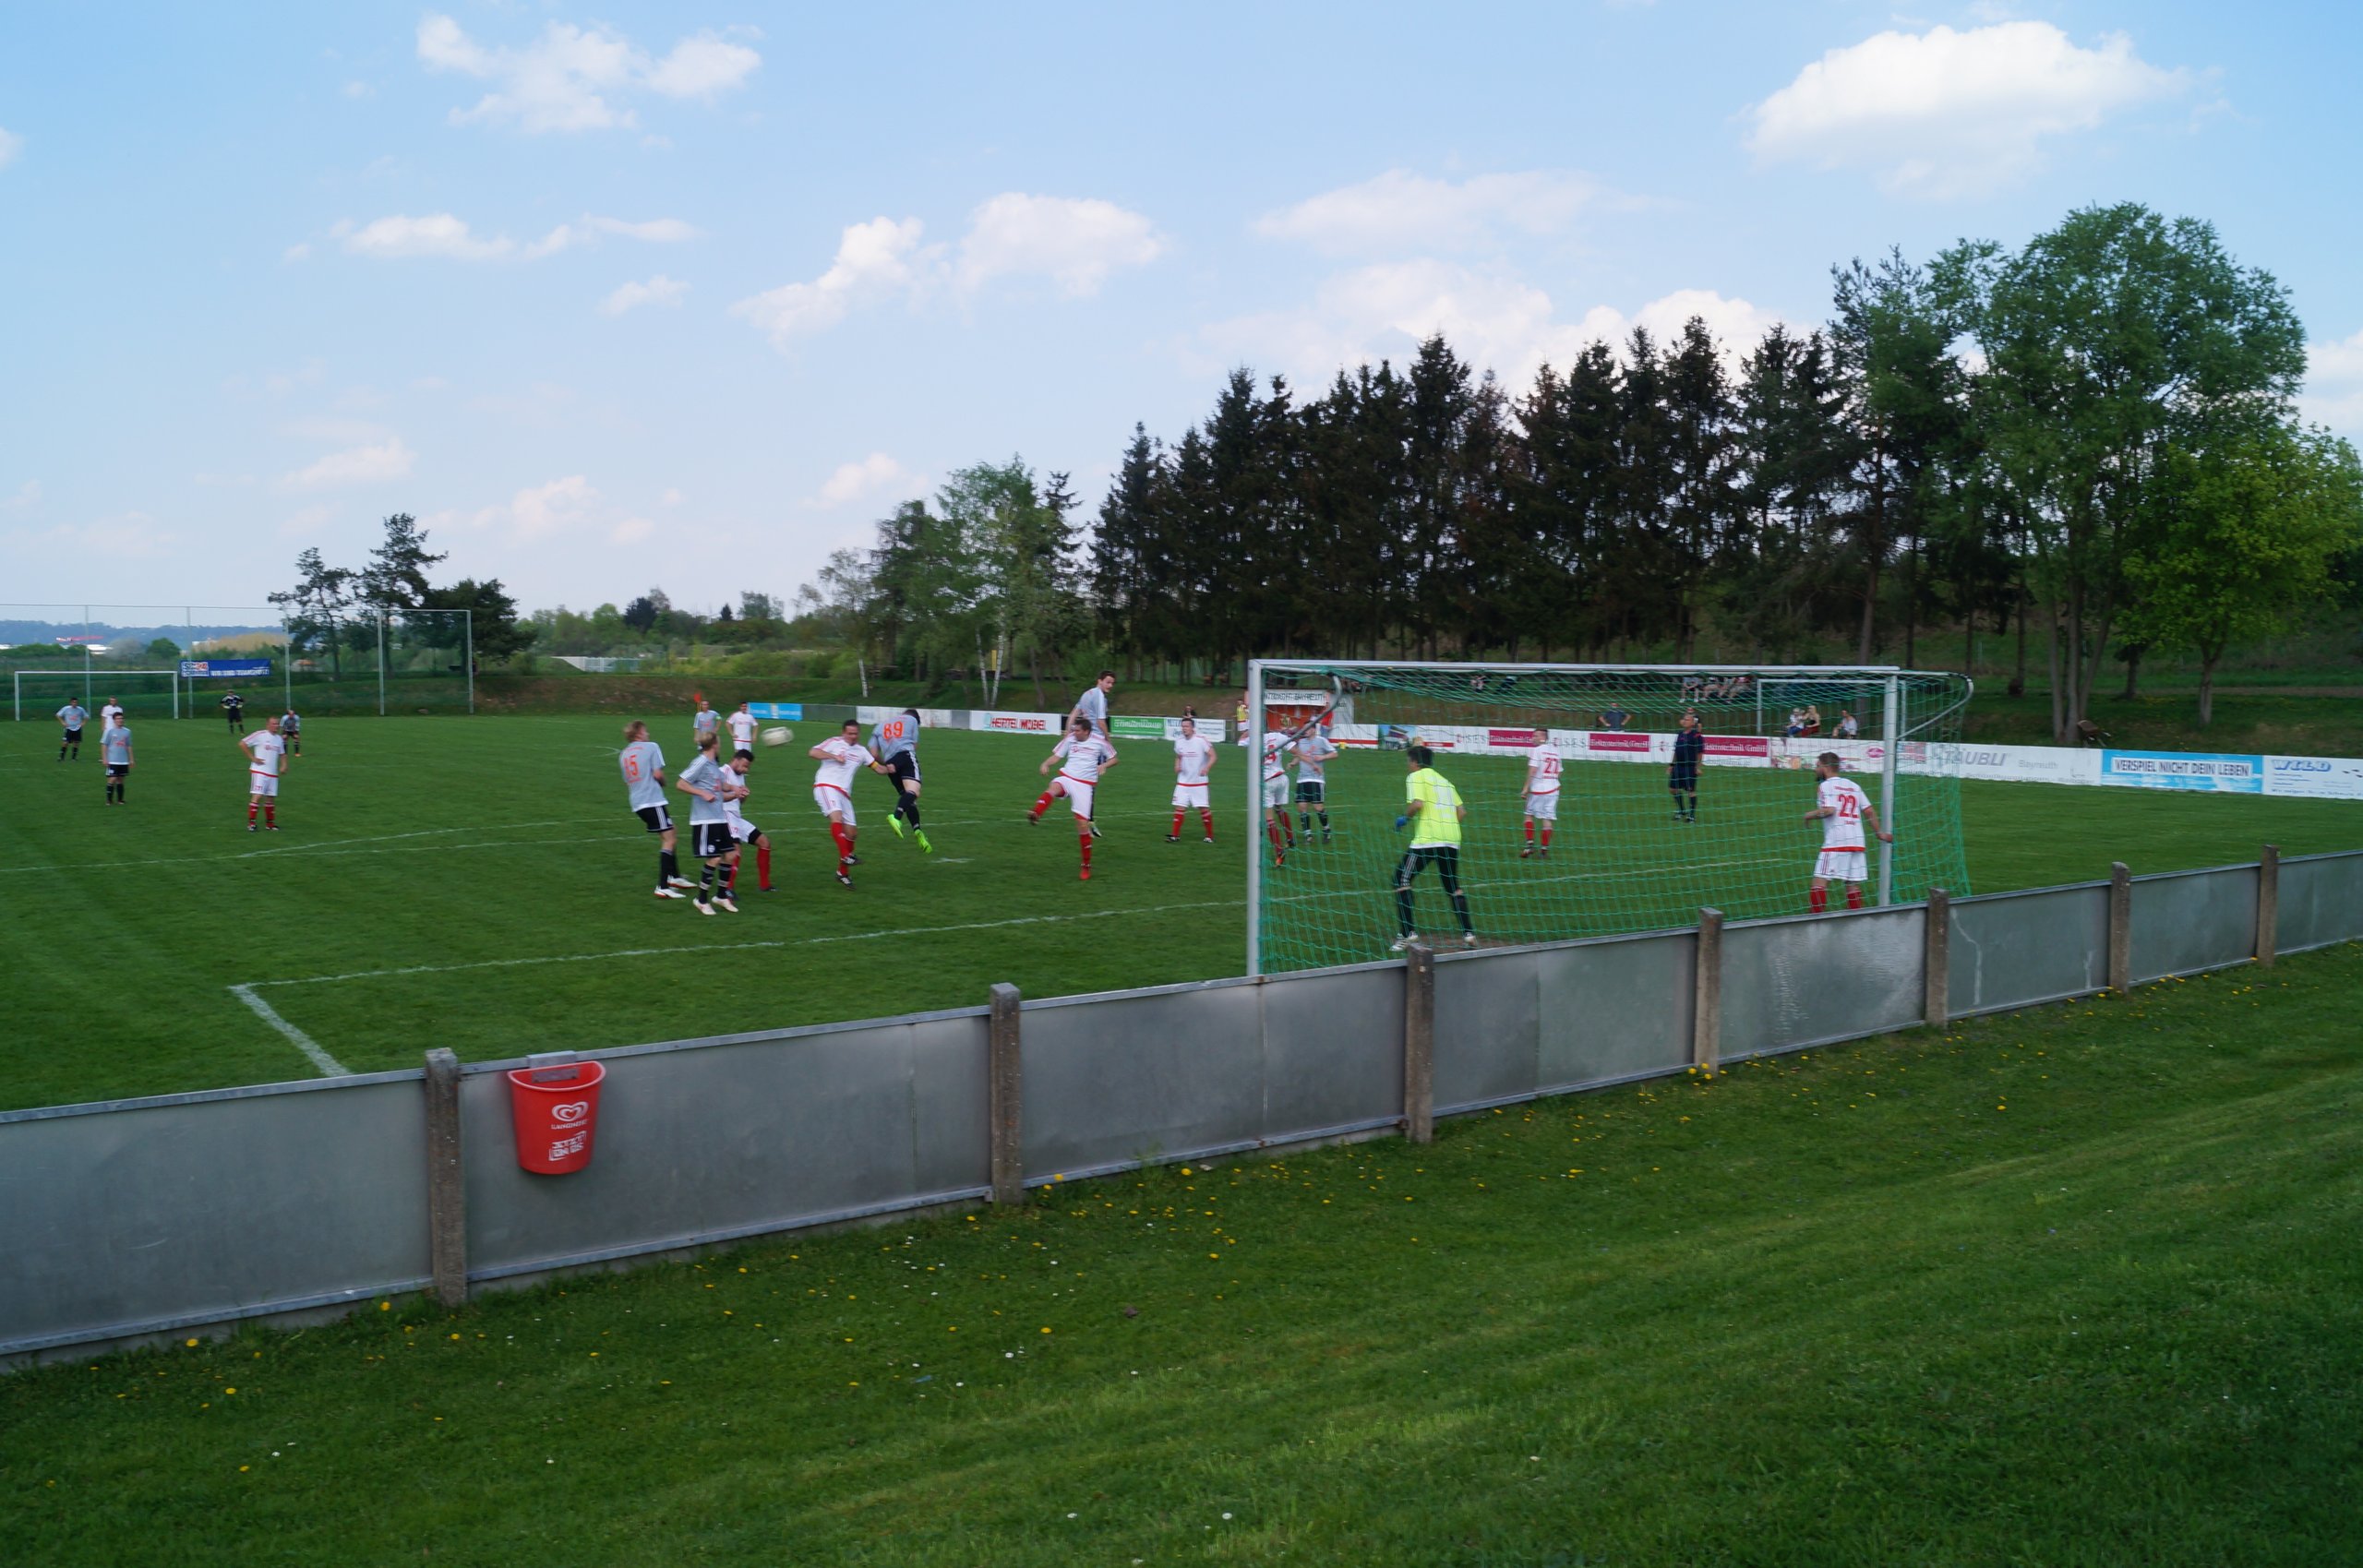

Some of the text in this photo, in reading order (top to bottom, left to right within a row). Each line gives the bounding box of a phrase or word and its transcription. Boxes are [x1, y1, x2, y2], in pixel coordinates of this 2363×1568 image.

[883, 721, 904, 739] 89
[2116, 759, 2249, 776] VERSPIEL NICHT DEIN LEBEN
[2272, 760, 2332, 772] WILD
[1838, 794, 1859, 819] 22
